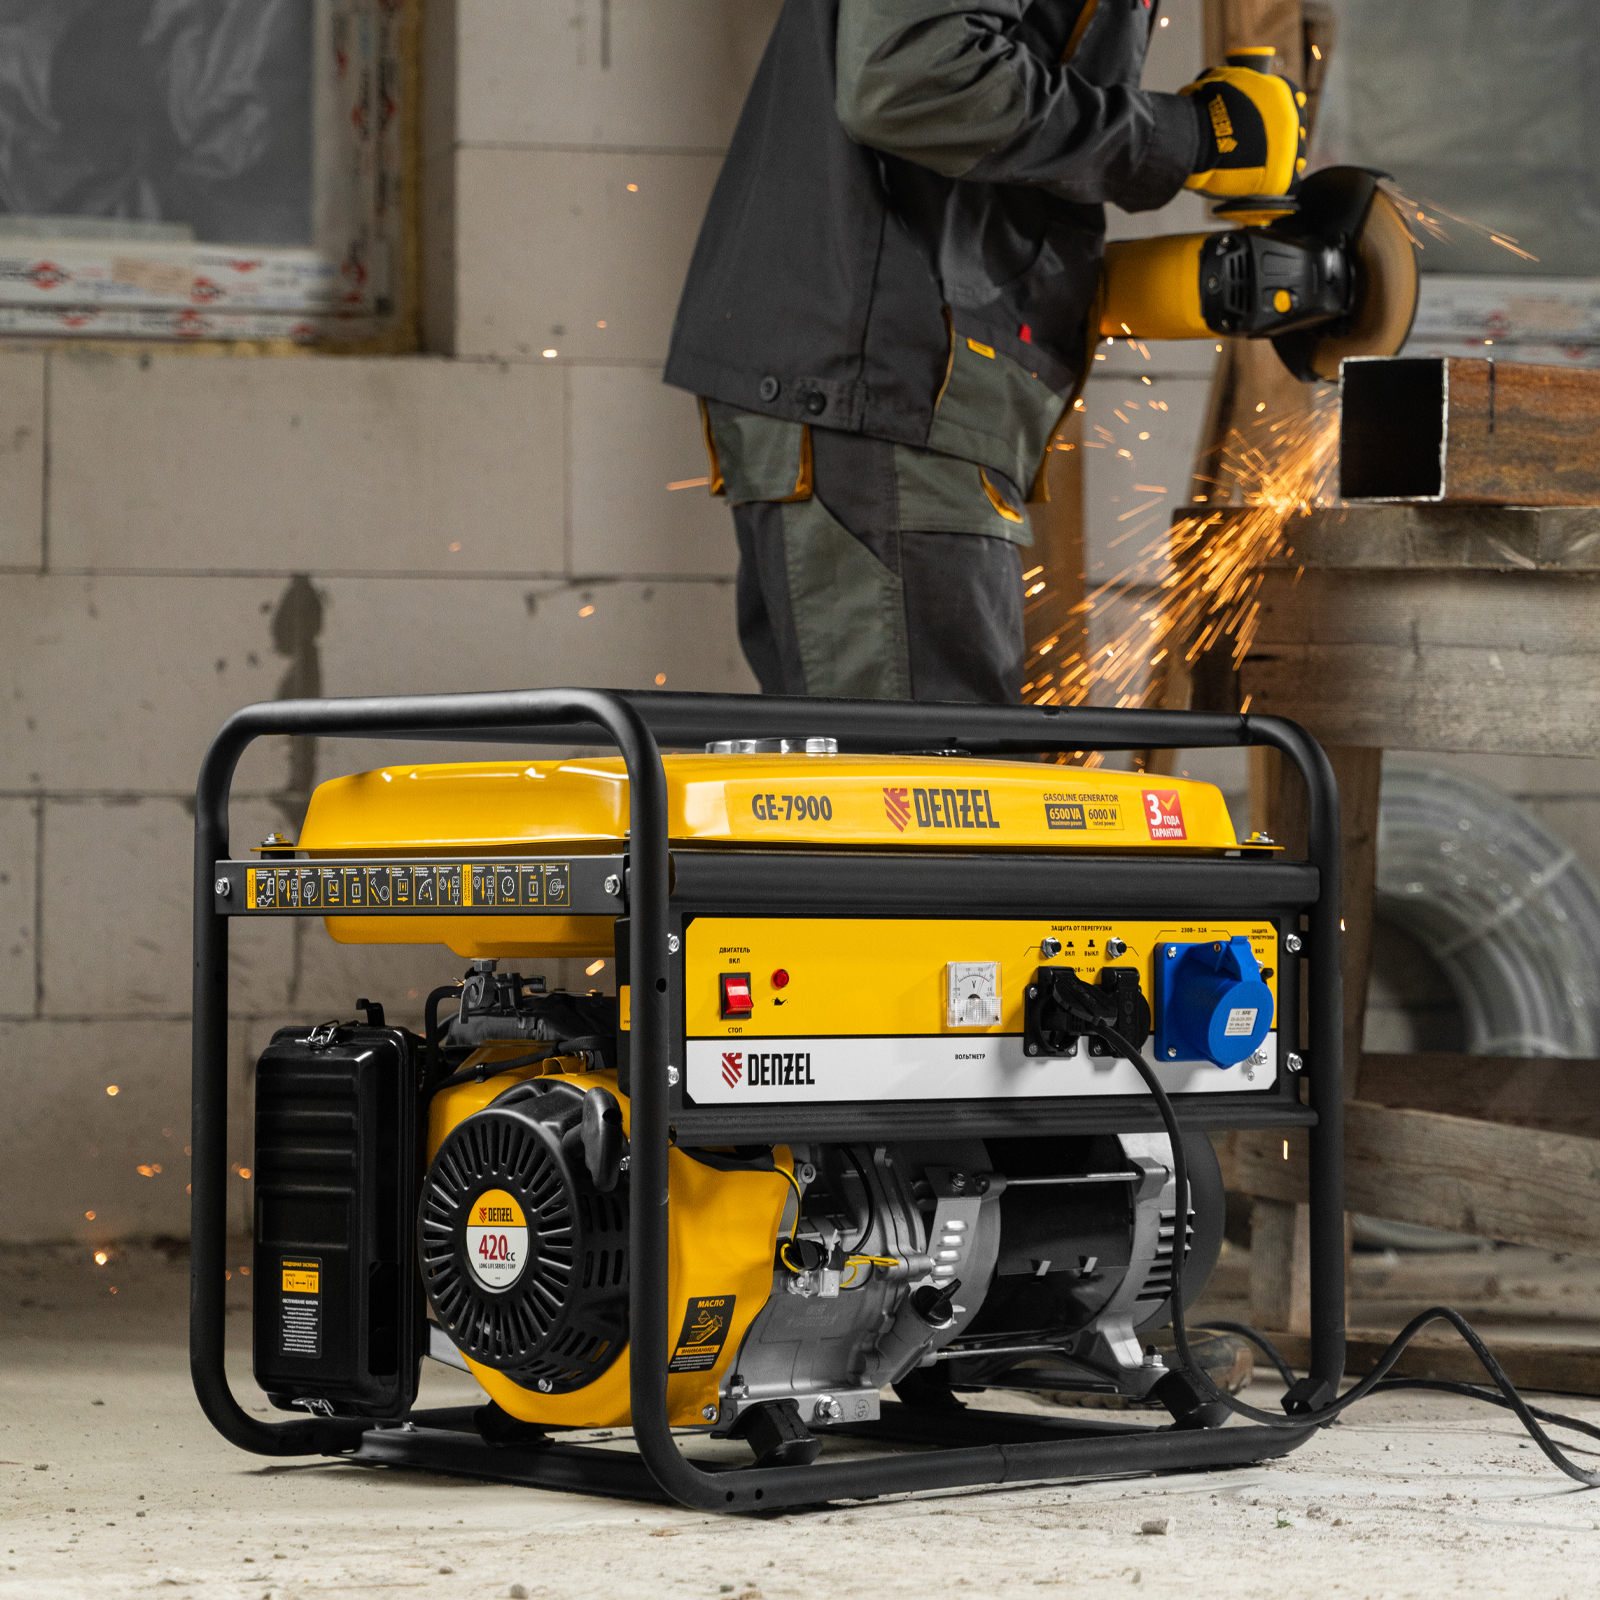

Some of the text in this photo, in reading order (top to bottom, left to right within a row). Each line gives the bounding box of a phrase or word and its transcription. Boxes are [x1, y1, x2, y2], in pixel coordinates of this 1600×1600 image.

[1043, 794, 1119, 802] GASOLINE GENERATOR
[752, 794, 832, 821] GE-7900
[913, 788, 1000, 828] DENZEL
[1147, 794, 1181, 826] 3 ГОДА
[1050, 808, 1082, 820] 6500 VA
[1089, 809, 1117, 820] 6000 W
[1152, 828, 1183, 838] ГАРАНТИИ
[972, 980, 976, 988] V
[748, 1053, 815, 1086] DENZEL
[489, 1208, 513, 1222] DENZEL
[697, 1300, 725, 1308] МАСЛО
